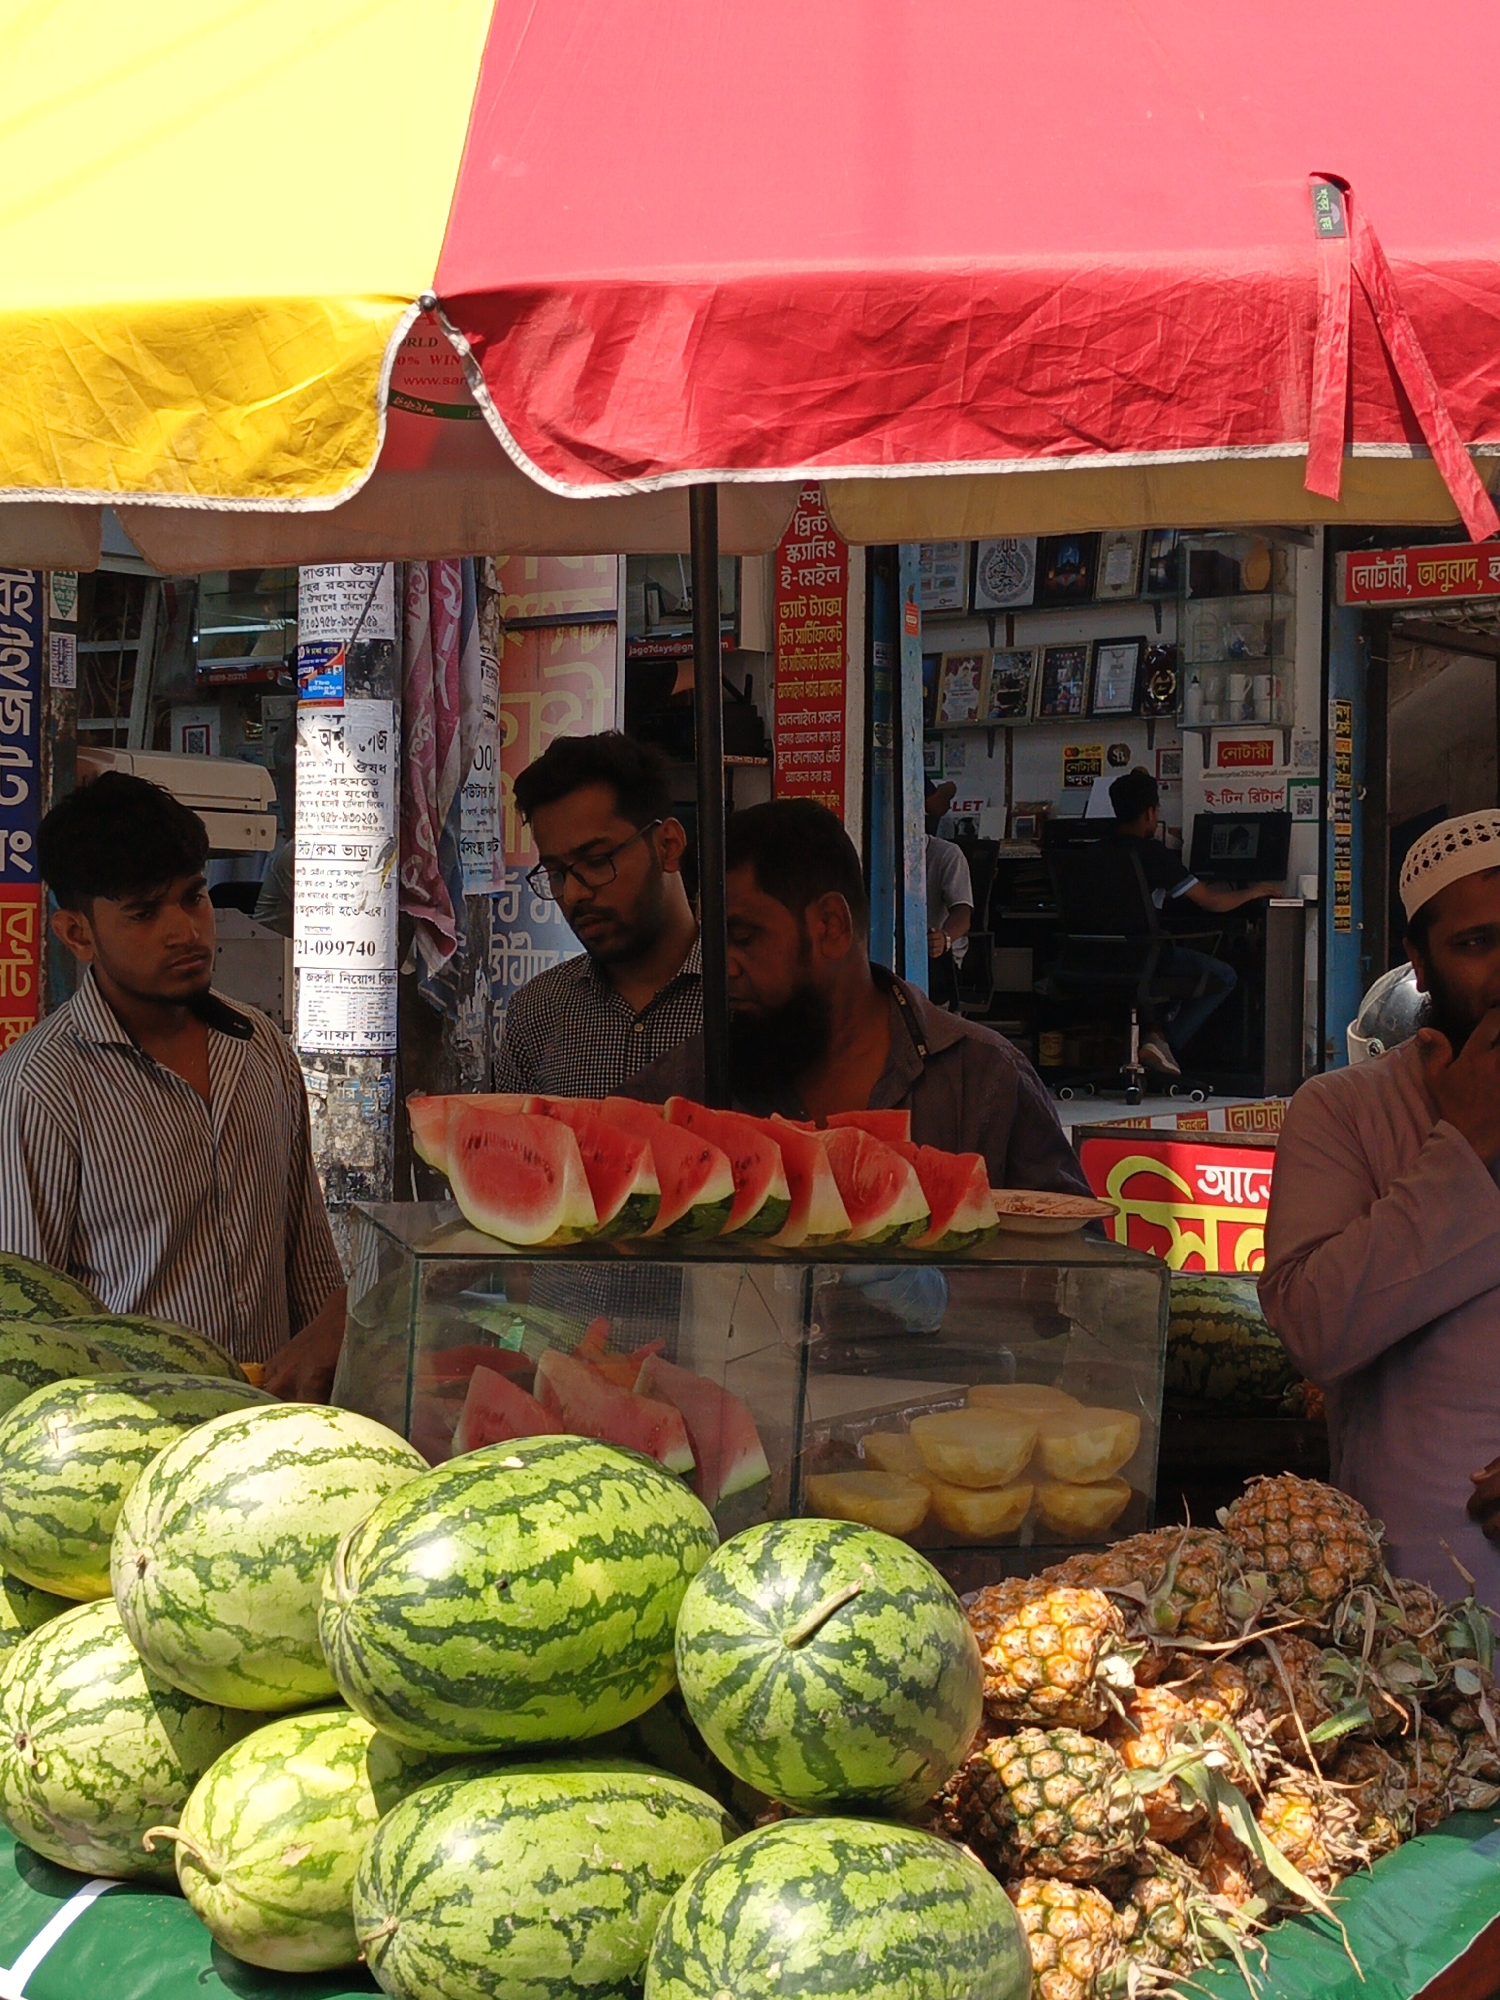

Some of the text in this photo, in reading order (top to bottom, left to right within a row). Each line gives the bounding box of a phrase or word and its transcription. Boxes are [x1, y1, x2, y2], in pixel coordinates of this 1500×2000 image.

[402, 337, 438, 348] RLD
[397, 355, 461, 366] 0% WIN
[793, 511, 828, 537] প্রিন্ট
[785, 535, 836, 563] স্ক্যানিং
[781, 563, 841, 590] ই-মেইল
[1352, 554, 1412, 595] নোটারী,
[1417, 558, 1483, 593] অনুবাদ,
[779, 594, 842, 619] ভ্যাট ট্যাক্স
[1221, 741, 1271, 760] নোটারী
[1204, 786, 1285, 806] ই-টিন রিটার্ন
[341, 844, 373, 860] ভাড়া
[339, 971, 376, 985] নিয়োগ
